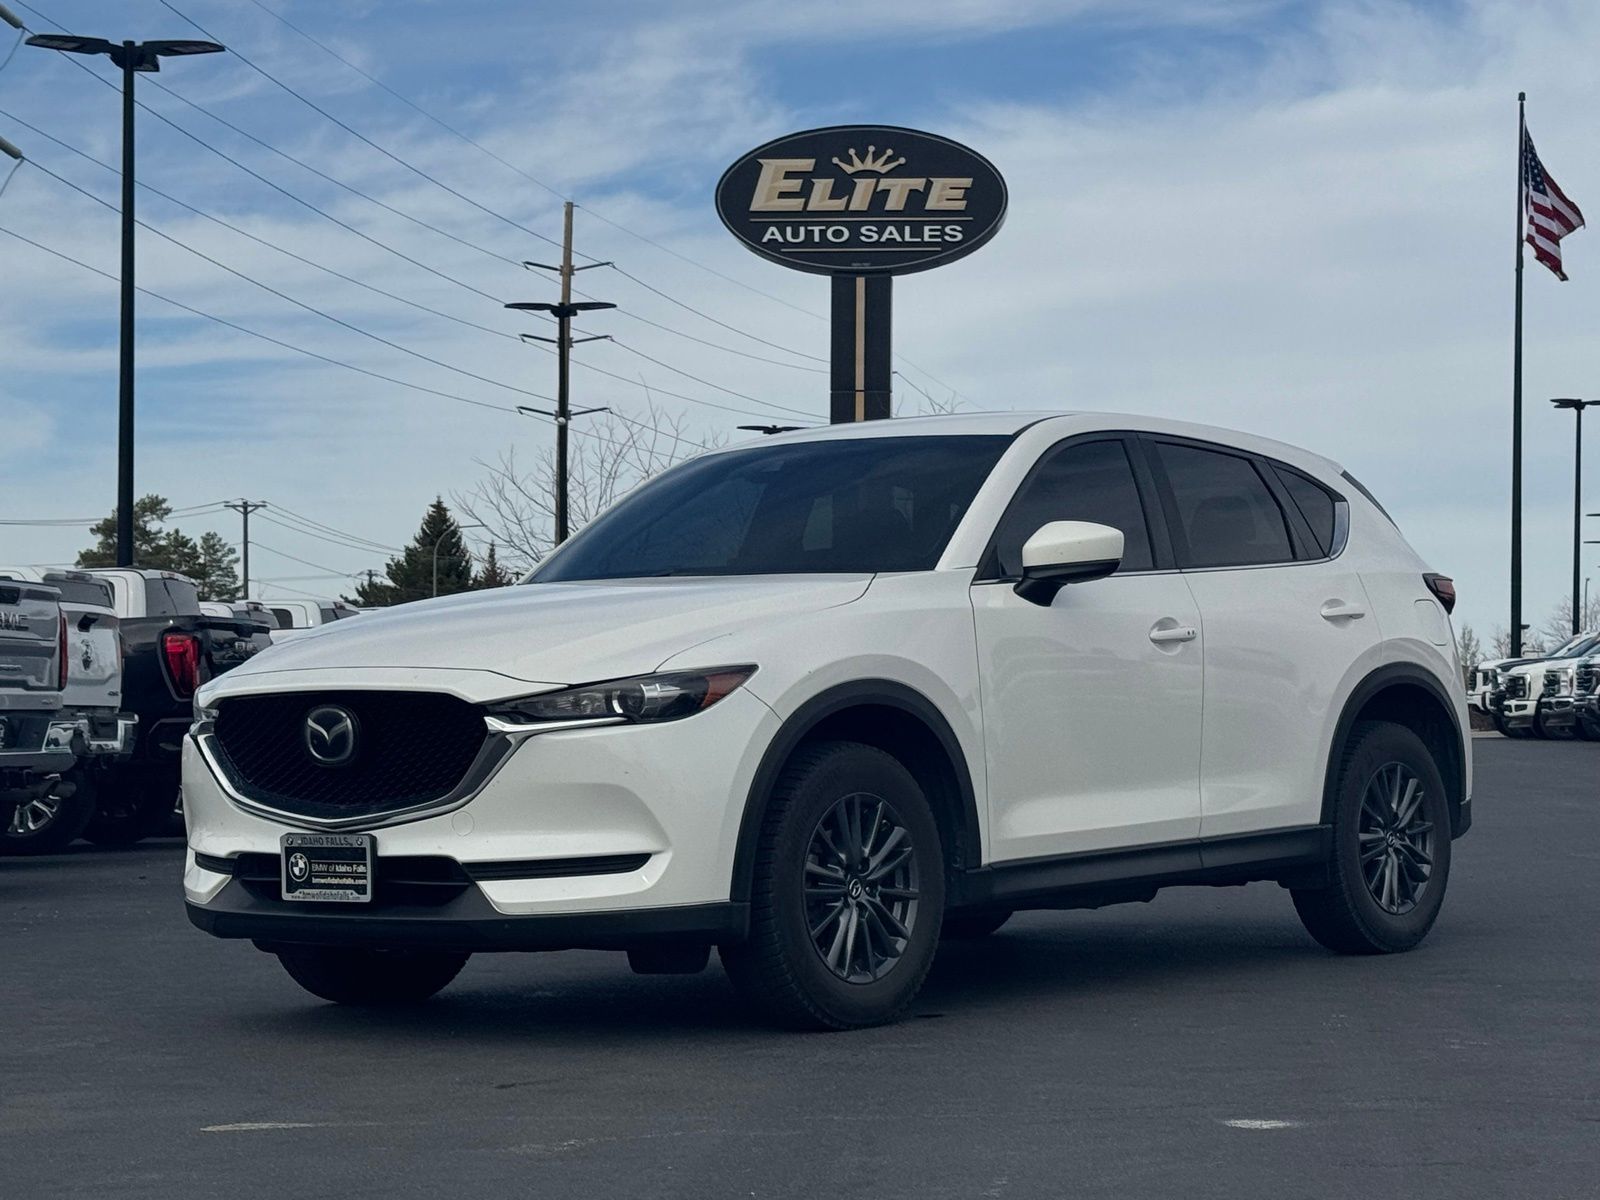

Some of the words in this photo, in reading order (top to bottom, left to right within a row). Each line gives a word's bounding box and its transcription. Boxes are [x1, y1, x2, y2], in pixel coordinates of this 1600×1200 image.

[749, 158, 973, 211] ELITE
[762, 225, 850, 243] AUTO
[859, 225, 963, 242] SALES
[301, 836, 323, 846] IDAHO
[325, 837, 350, 847] FALLS
[312, 863, 327, 872] BMW
[335, 863, 352, 873] Idaho
[352, 864, 367, 873] Falls
